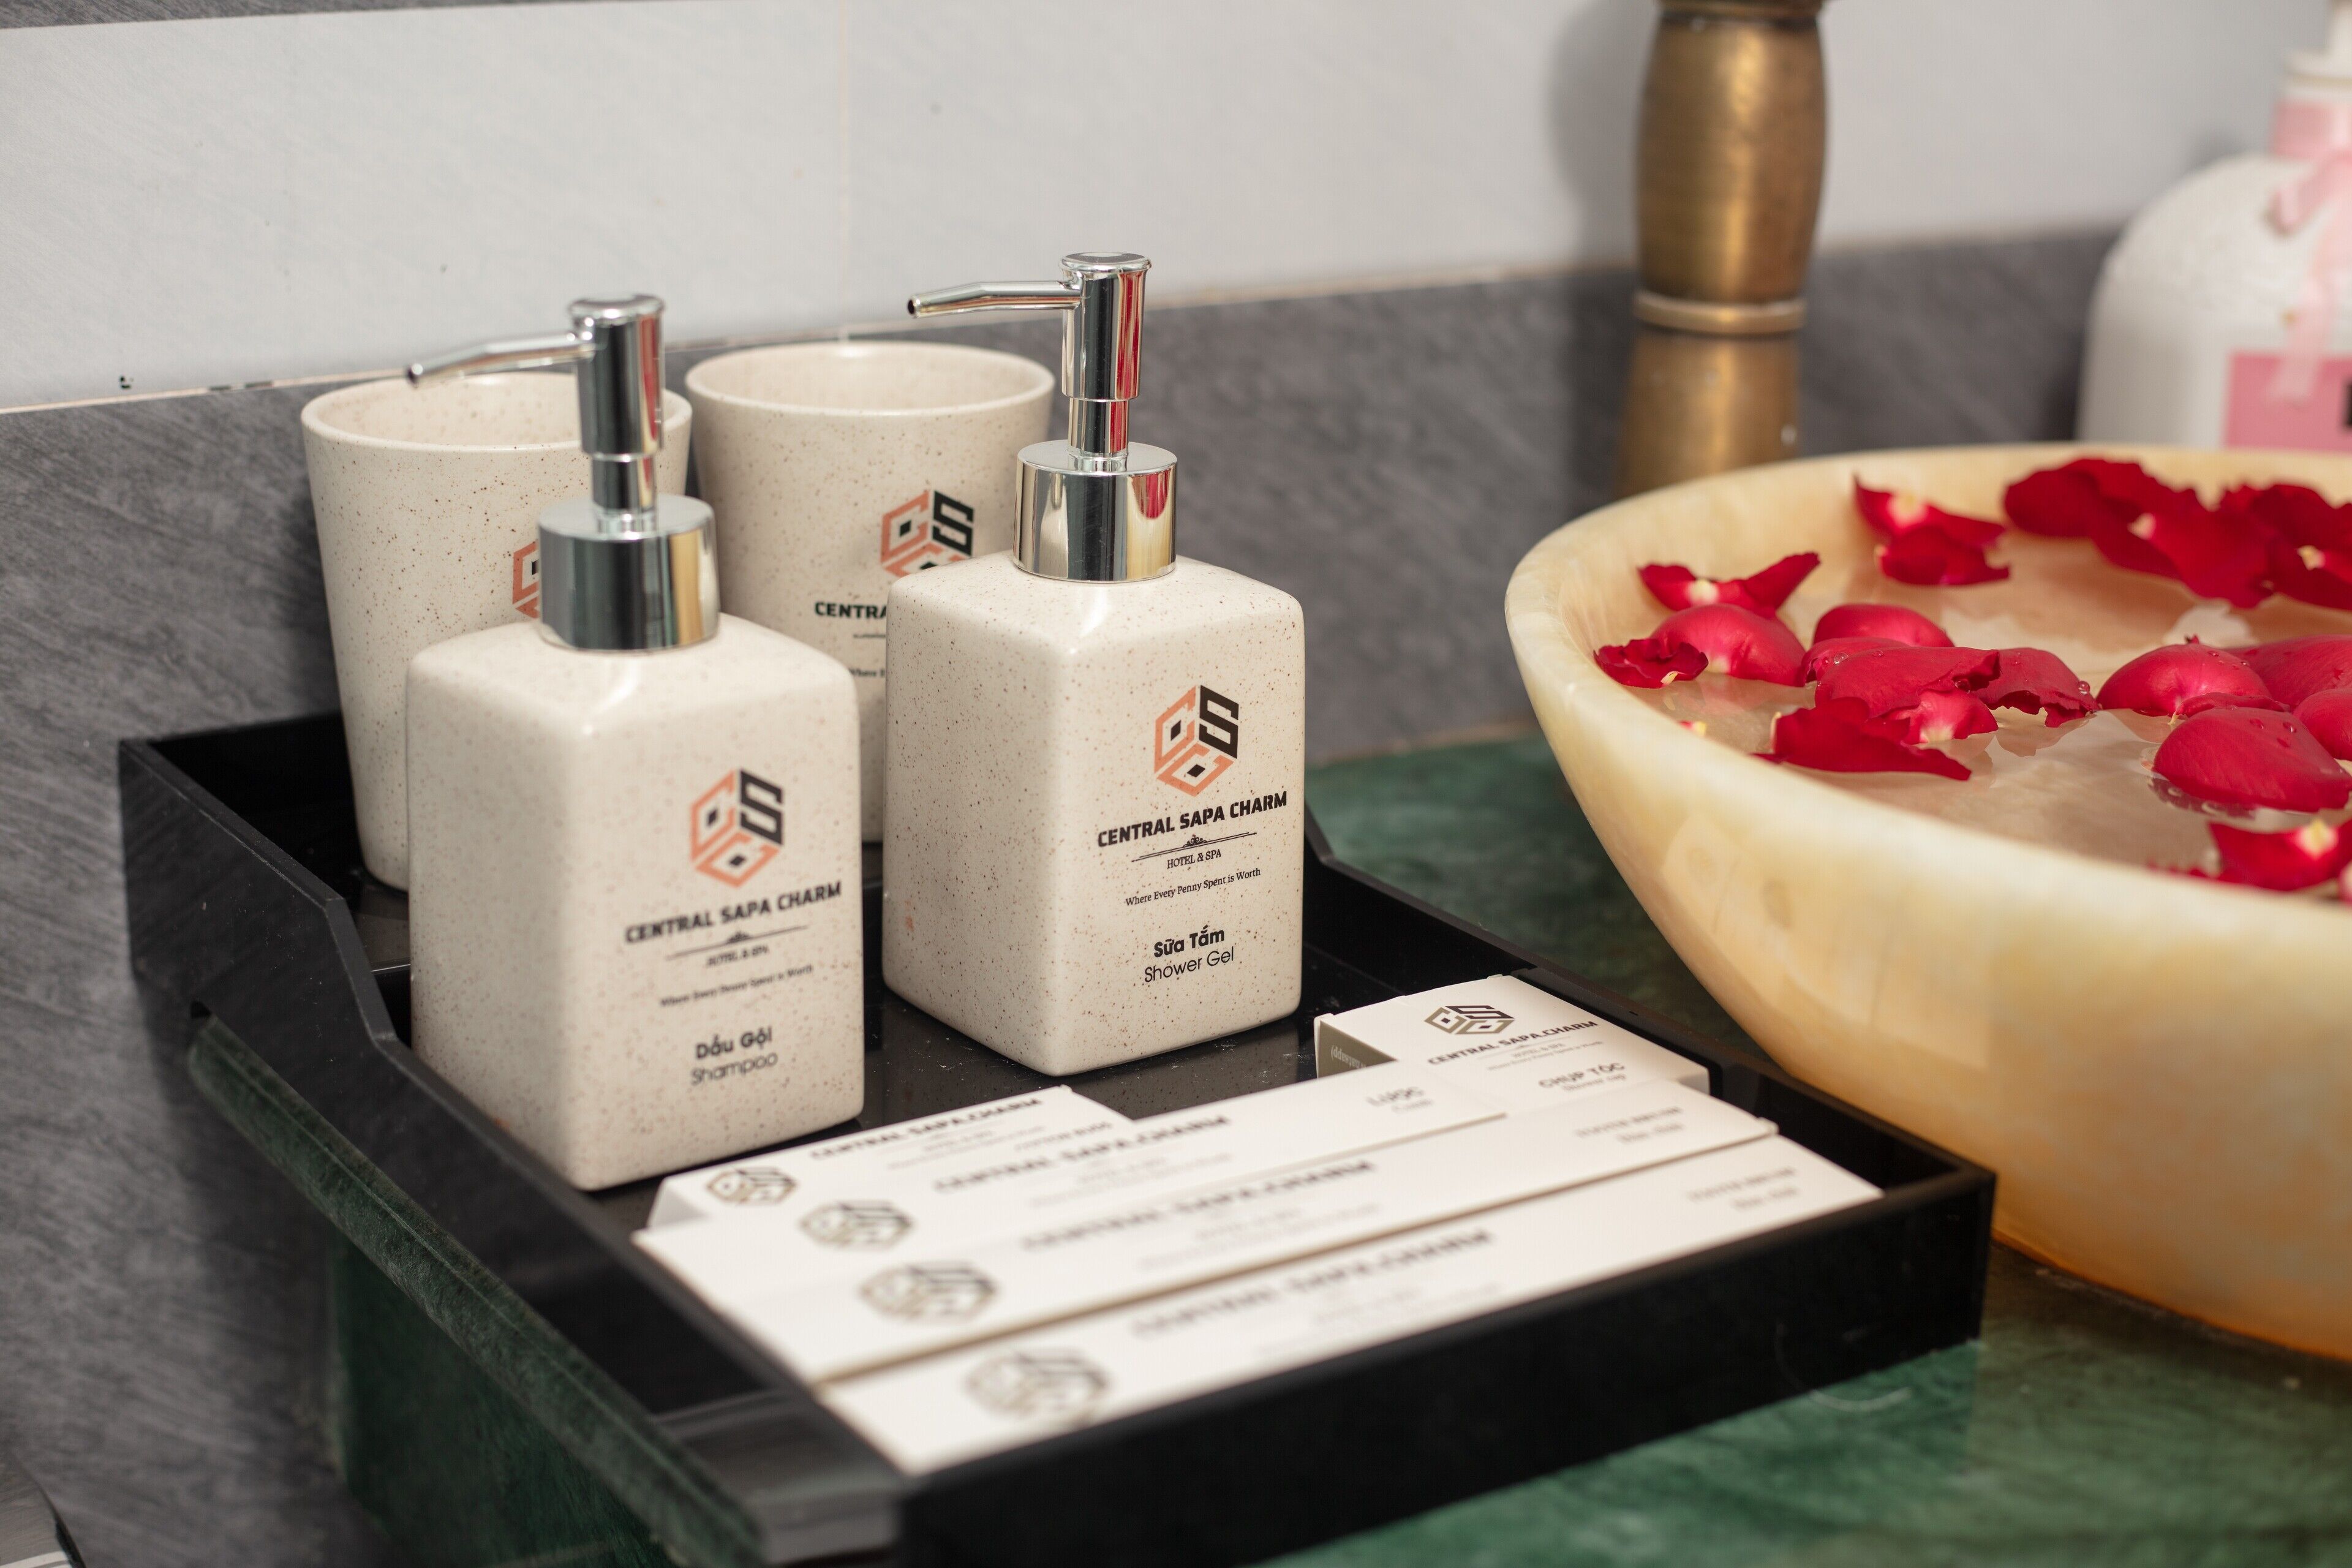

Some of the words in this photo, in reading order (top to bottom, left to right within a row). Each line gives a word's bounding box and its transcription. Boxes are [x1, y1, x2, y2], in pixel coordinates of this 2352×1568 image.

[1098, 816, 1175, 848] CENTRAL
[1180, 805, 1225, 829] SAPA
[1229, 790, 1287, 818] CHARM
[1167, 854, 1196, 869] HOTEL
[1197, 853, 1204, 862] &
[1205, 849, 1221, 861] SPA
[1126, 892, 1152, 906] Where
[1154, 888, 1175, 900] Every
[1177, 883, 1202, 895] Penny
[1204, 876, 1226, 889] Spent
[1227, 874, 1234, 883] is
[1236, 867, 1261, 881] Worth
[625, 911, 714, 943] CENTRAL
[720, 897, 771, 923] SAPA
[777, 880, 842, 911] CHARM
[1154, 938, 1185, 958] Sữa
[1189, 924, 1225, 949] Tắm
[1144, 957, 1202, 982] Shower
[1207, 946, 1234, 967] Gel
[691, 1052, 779, 1085] Shampoo
